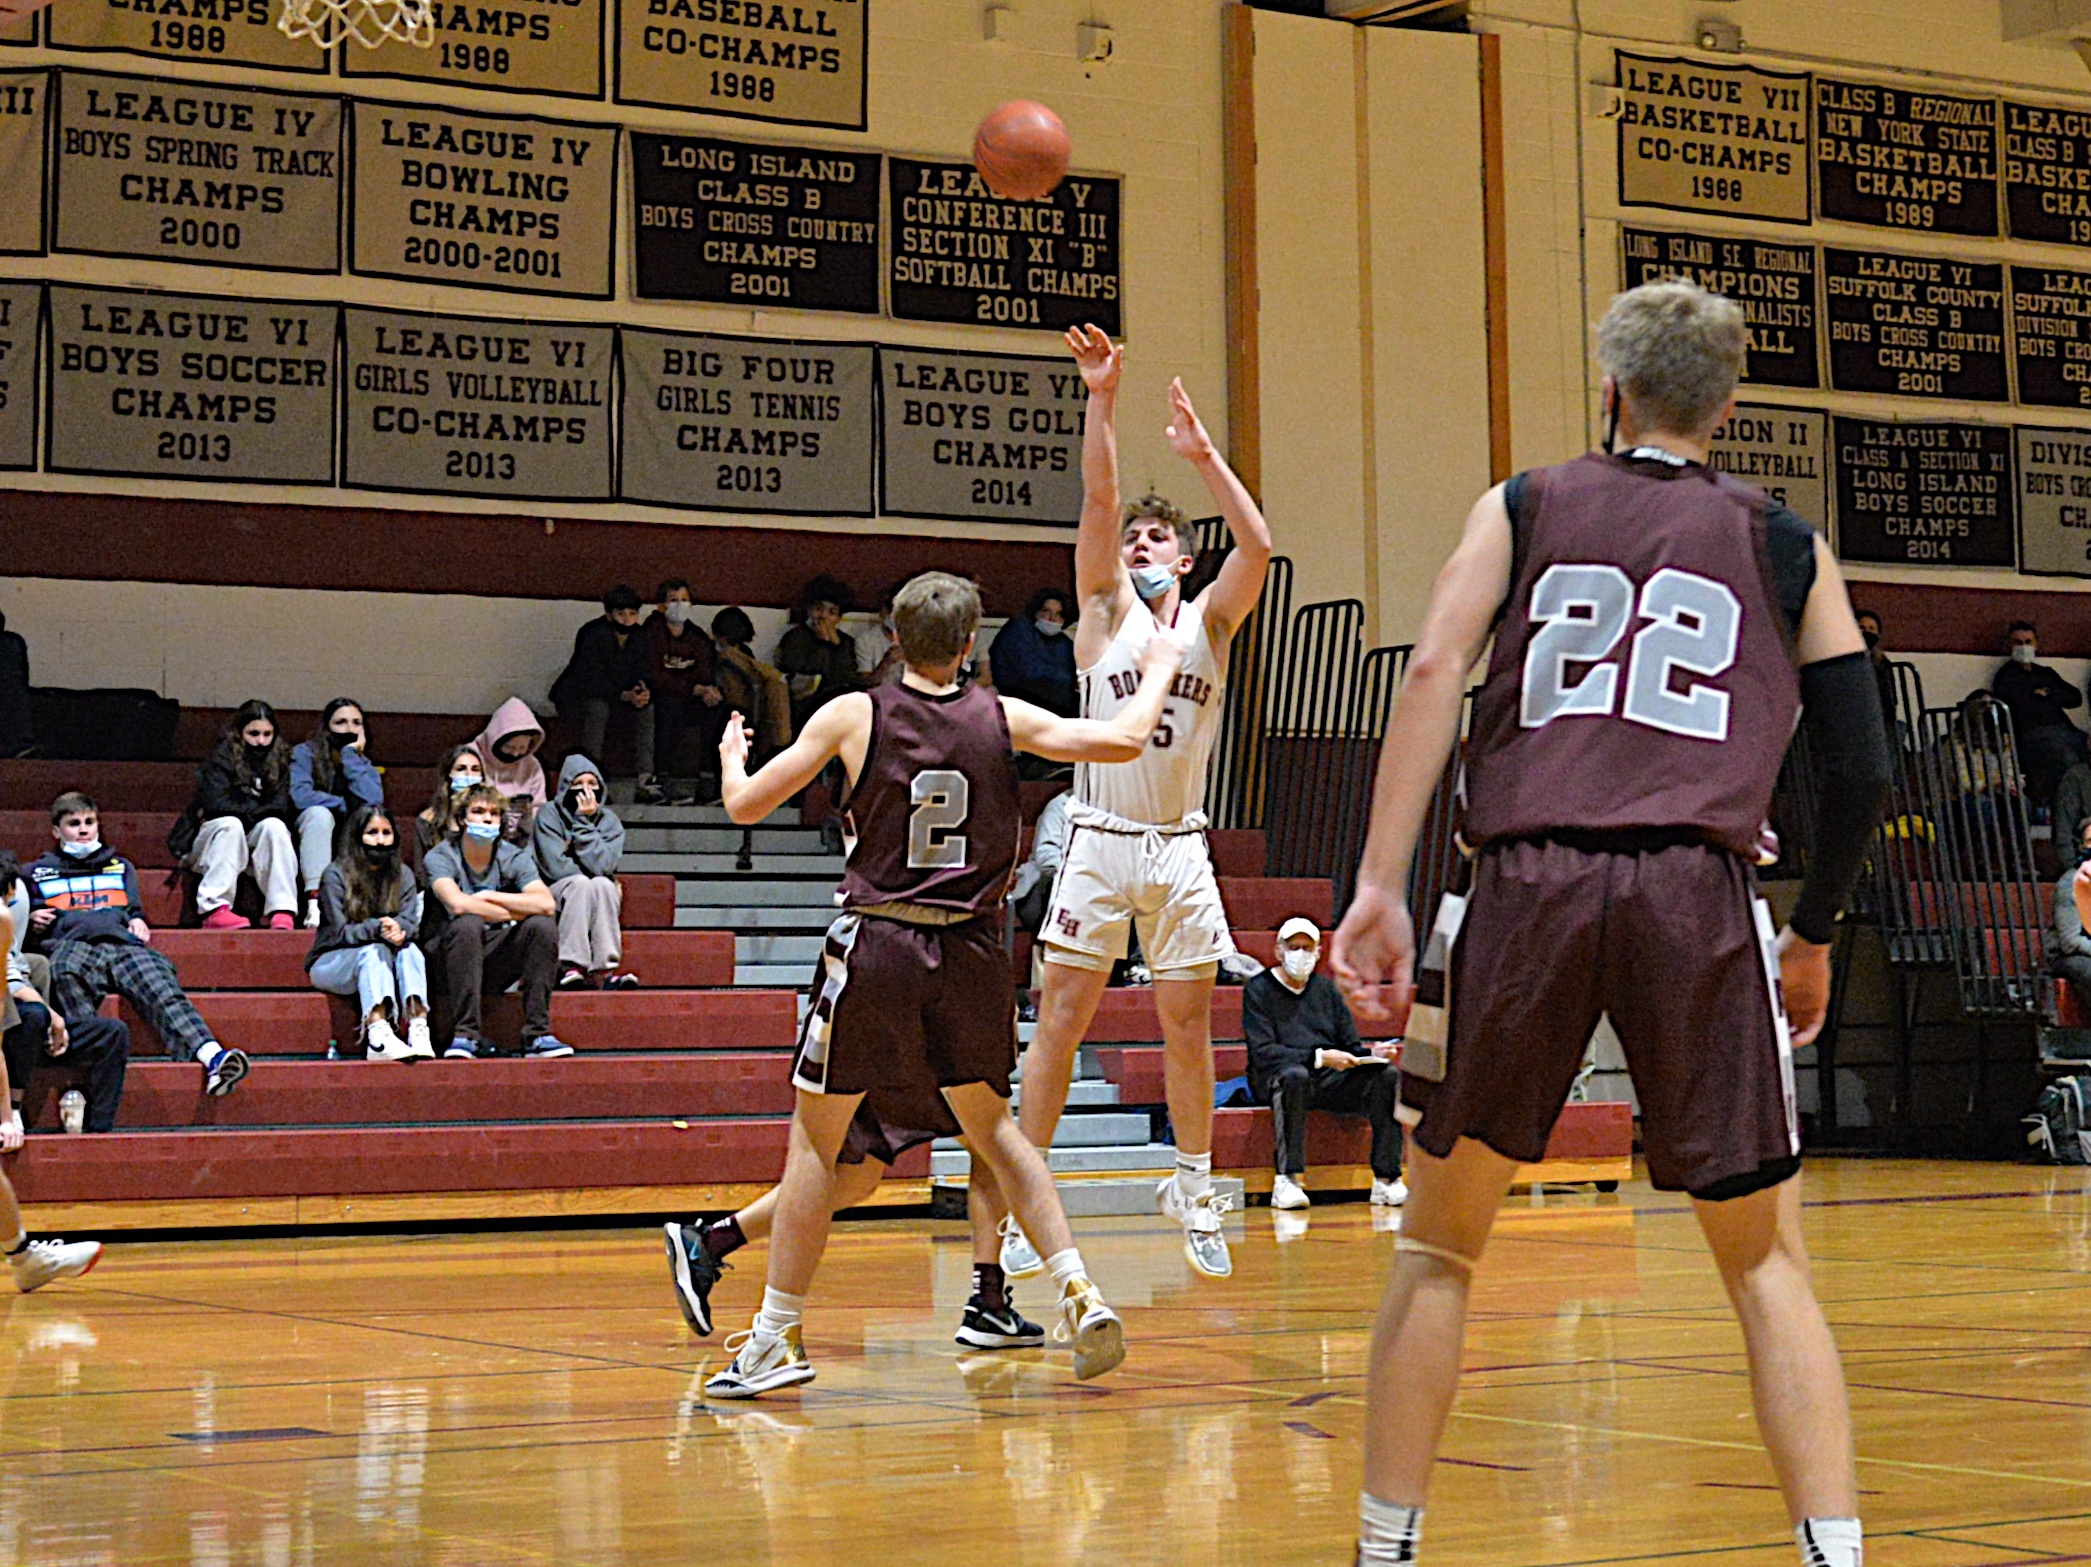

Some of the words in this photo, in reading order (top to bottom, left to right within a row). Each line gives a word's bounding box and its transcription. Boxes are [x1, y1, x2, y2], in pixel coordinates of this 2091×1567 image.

[648, 0, 837, 37] BASEBALL
[151, 20, 226, 53] 1988
[440, 42, 510, 74] 1988
[710, 70, 775, 103] 1988
[1628, 68, 1742, 104] LEAGUE
[1763, 86, 1800, 112] VII
[86, 89, 254, 132] LEAGUE
[274, 108, 316, 138] IV
[1816, 83, 1877, 113] CLASS
[1882, 92, 1896, 116] B
[1910, 96, 1996, 127] REGIONAL
[1622, 101, 1805, 145] BASKETBALL
[1825, 111, 1864, 139] NEW
[1877, 118, 1926, 147] YORK
[1937, 126, 1991, 154] STATE
[65, 127, 131, 161] BOYS
[145, 135, 239, 172] SPRING
[254, 145, 335, 179] TRACK
[381, 118, 533, 161] LEAGUE
[552, 137, 590, 166] IV
[1818, 137, 1997, 181] BASKETBALL
[2006, 133, 2057, 161] CLASS
[2062, 140, 2075, 163] B
[401, 159, 569, 202] BOWLING
[661, 144, 736, 173] LONG
[750, 153, 856, 183] ISLAND
[120, 173, 285, 214] CHAMPS
[697, 178, 790, 209] CLASS
[803, 188, 821, 211] B
[918, 168, 1054, 205] LEA
[1069, 182, 1092, 208] V
[1691, 175, 1743, 203] 1988
[1855, 171, 1963, 205] CHAMPS
[409, 198, 560, 240] CHAMPS
[640, 204, 694, 230] BOYS
[708, 210, 774, 236] CROSS
[787, 216, 876, 245] COUNTRY
[903, 196, 1065, 235] CONFERENCE
[1077, 212, 1107, 240] III
[1884, 201, 1935, 228] 1989
[160, 217, 241, 250] 2000
[902, 226, 1010, 260] SECTION
[1027, 236, 1054, 263] XI
[404, 236, 562, 278] 2000-2001
[703, 240, 818, 270] CHAMPS
[1668, 238, 1713, 265] ISLAND
[730, 272, 791, 298] 2001
[894, 255, 1012, 291] SOFTBALL
[1027, 267, 1118, 300] CHAMPS
[1857, 256, 1942, 283] LEAGUE
[1951, 265, 1973, 286] VI
[976, 294, 1041, 324] 2001
[1828, 276, 1917, 303] SUFFOLK
[1926, 286, 2001, 309] COUNTY
[81, 303, 249, 343] LEAGUE
[269, 318, 309, 346] VI
[1872, 302, 1939, 327] CLASS
[1949, 309, 1962, 329] B
[2015, 315, 2079, 338] DIVISION
[375, 326, 530, 365] LEAGUE
[551, 340, 586, 368] VI
[1832, 320, 1872, 343] BOYS
[1880, 326, 1929, 348] CROSS
[2019, 337, 2057, 358] BOYS
[60, 342, 159, 377] BOYS
[181, 352, 327, 387] SOCCER
[663, 348, 723, 378] BIG
[741, 355, 836, 386] FOUR
[1877, 348, 1962, 373] CHAMPS
[2062, 363, 2091, 383] CH
[355, 363, 430, 396] GIRLS
[446, 371, 602, 407] VOLLEYBALL
[894, 362, 1030, 396] LEAGUE
[1898, 372, 1943, 393] 2001
[112, 387, 277, 424] CHAMPS
[657, 384, 732, 416] GIRLS
[749, 391, 841, 422] TENNIS
[903, 399, 990, 431] BOYS
[373, 405, 586, 444] CO-CHAMPS
[676, 424, 821, 459] CHAMPS
[1788, 422, 1808, 446] II
[1862, 426, 1949, 448] LEAGUE
[1959, 430, 1982, 449] VI
[157, 431, 231, 463] 2013
[933, 438, 1068, 472] CHAMPS
[1842, 445, 1890, 468] CLASS
[1919, 451, 1980, 471] SECTION
[446, 450, 516, 480] 2013
[716, 464, 782, 493] 2013
[1852, 468, 1907, 491] LONG
[1919, 473, 1998, 494] ISLAND
[971, 478, 1032, 506] 2014
[1854, 492, 1909, 513] BOYS
[1921, 495, 1997, 516] SOCCER
[1885, 516, 1970, 537] CHAMPS
[1906, 539, 1952, 559] 2014
[1519, 563, 1742, 742] 22
[1108, 668, 1212, 708] BOKERS
[907, 769, 969, 869] 2
